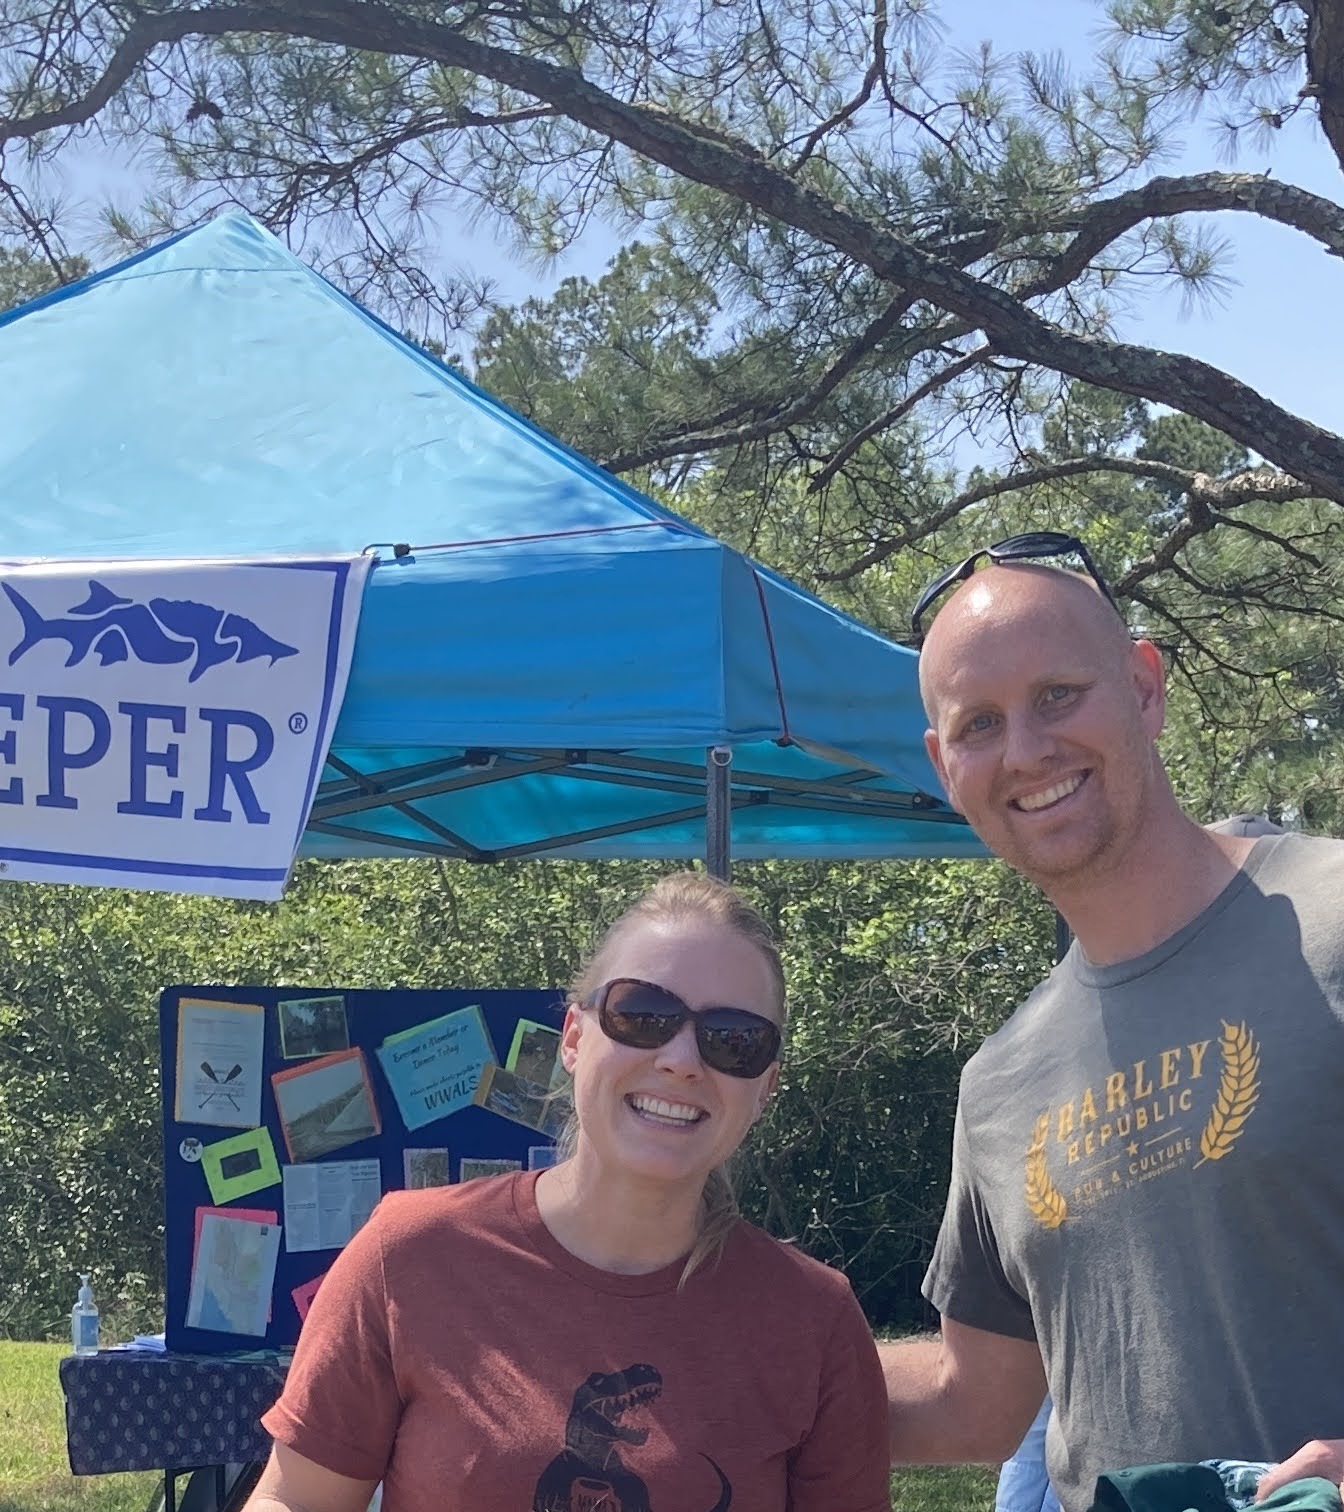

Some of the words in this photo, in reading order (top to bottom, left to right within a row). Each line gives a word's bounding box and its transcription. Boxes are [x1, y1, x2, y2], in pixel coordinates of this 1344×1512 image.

[424, 1075, 479, 1111] WWALS
[1056, 1039, 1213, 1143] BARLEY
[1067, 1088, 1193, 1167] REPUBLIC
[1128, 1137, 1193, 1176] CULTURE
